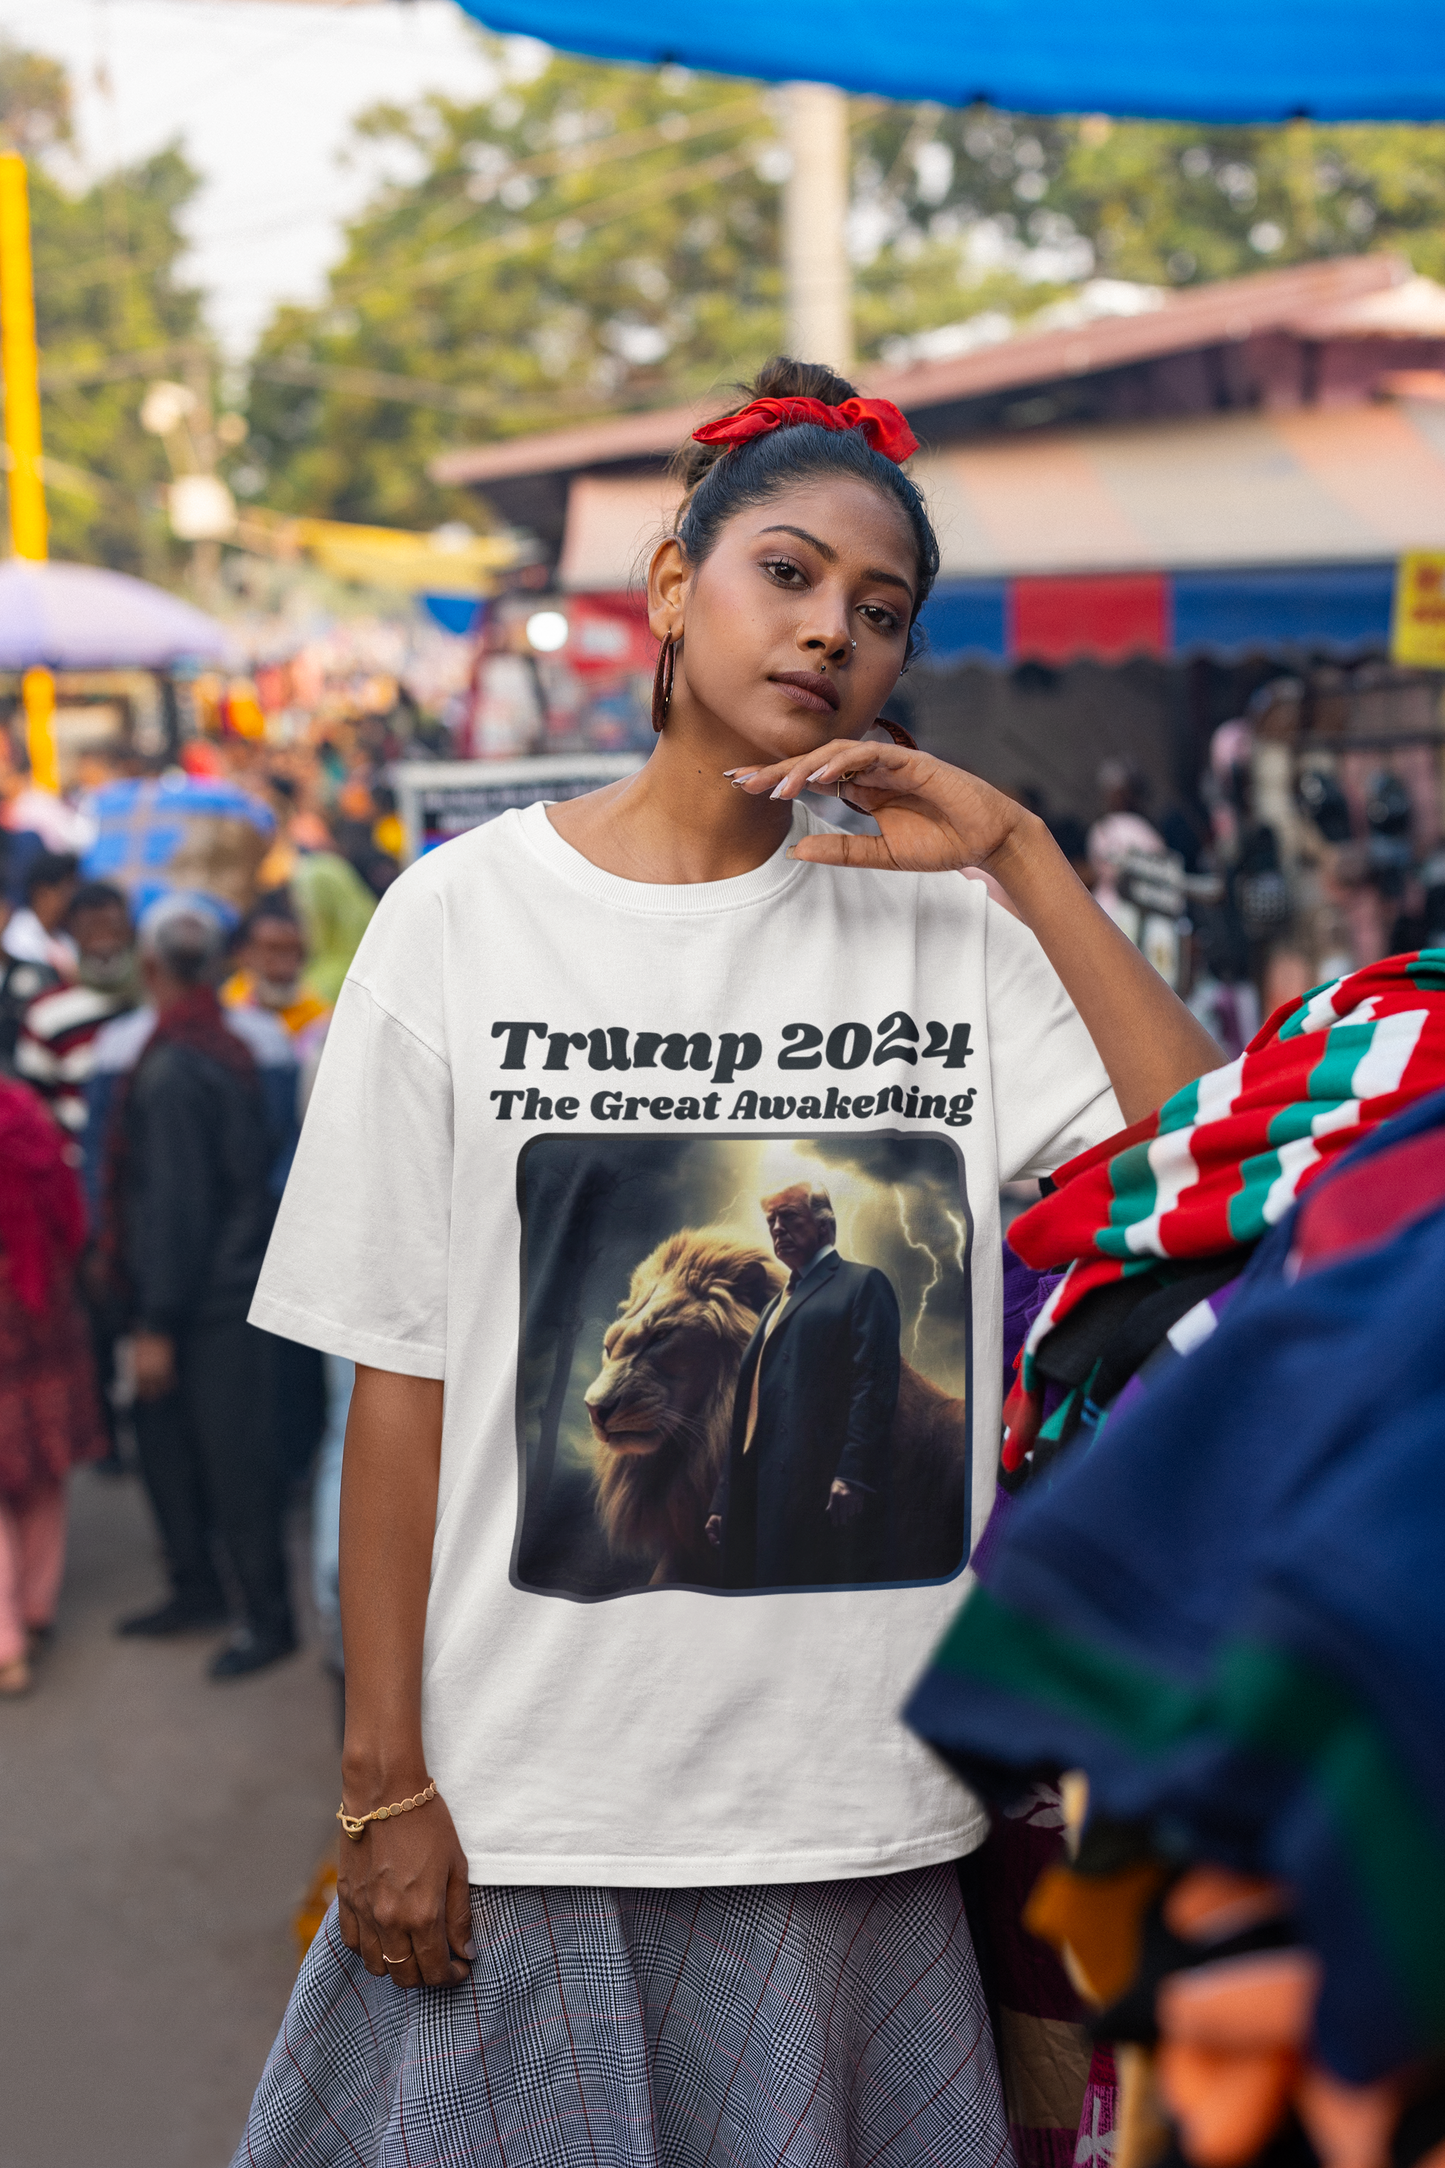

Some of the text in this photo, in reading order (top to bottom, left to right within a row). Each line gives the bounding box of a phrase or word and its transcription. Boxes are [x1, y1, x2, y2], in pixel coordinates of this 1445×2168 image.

[491, 1011, 974, 1084] Trump 2024
[489, 1084, 977, 1127] The Great Awakening
